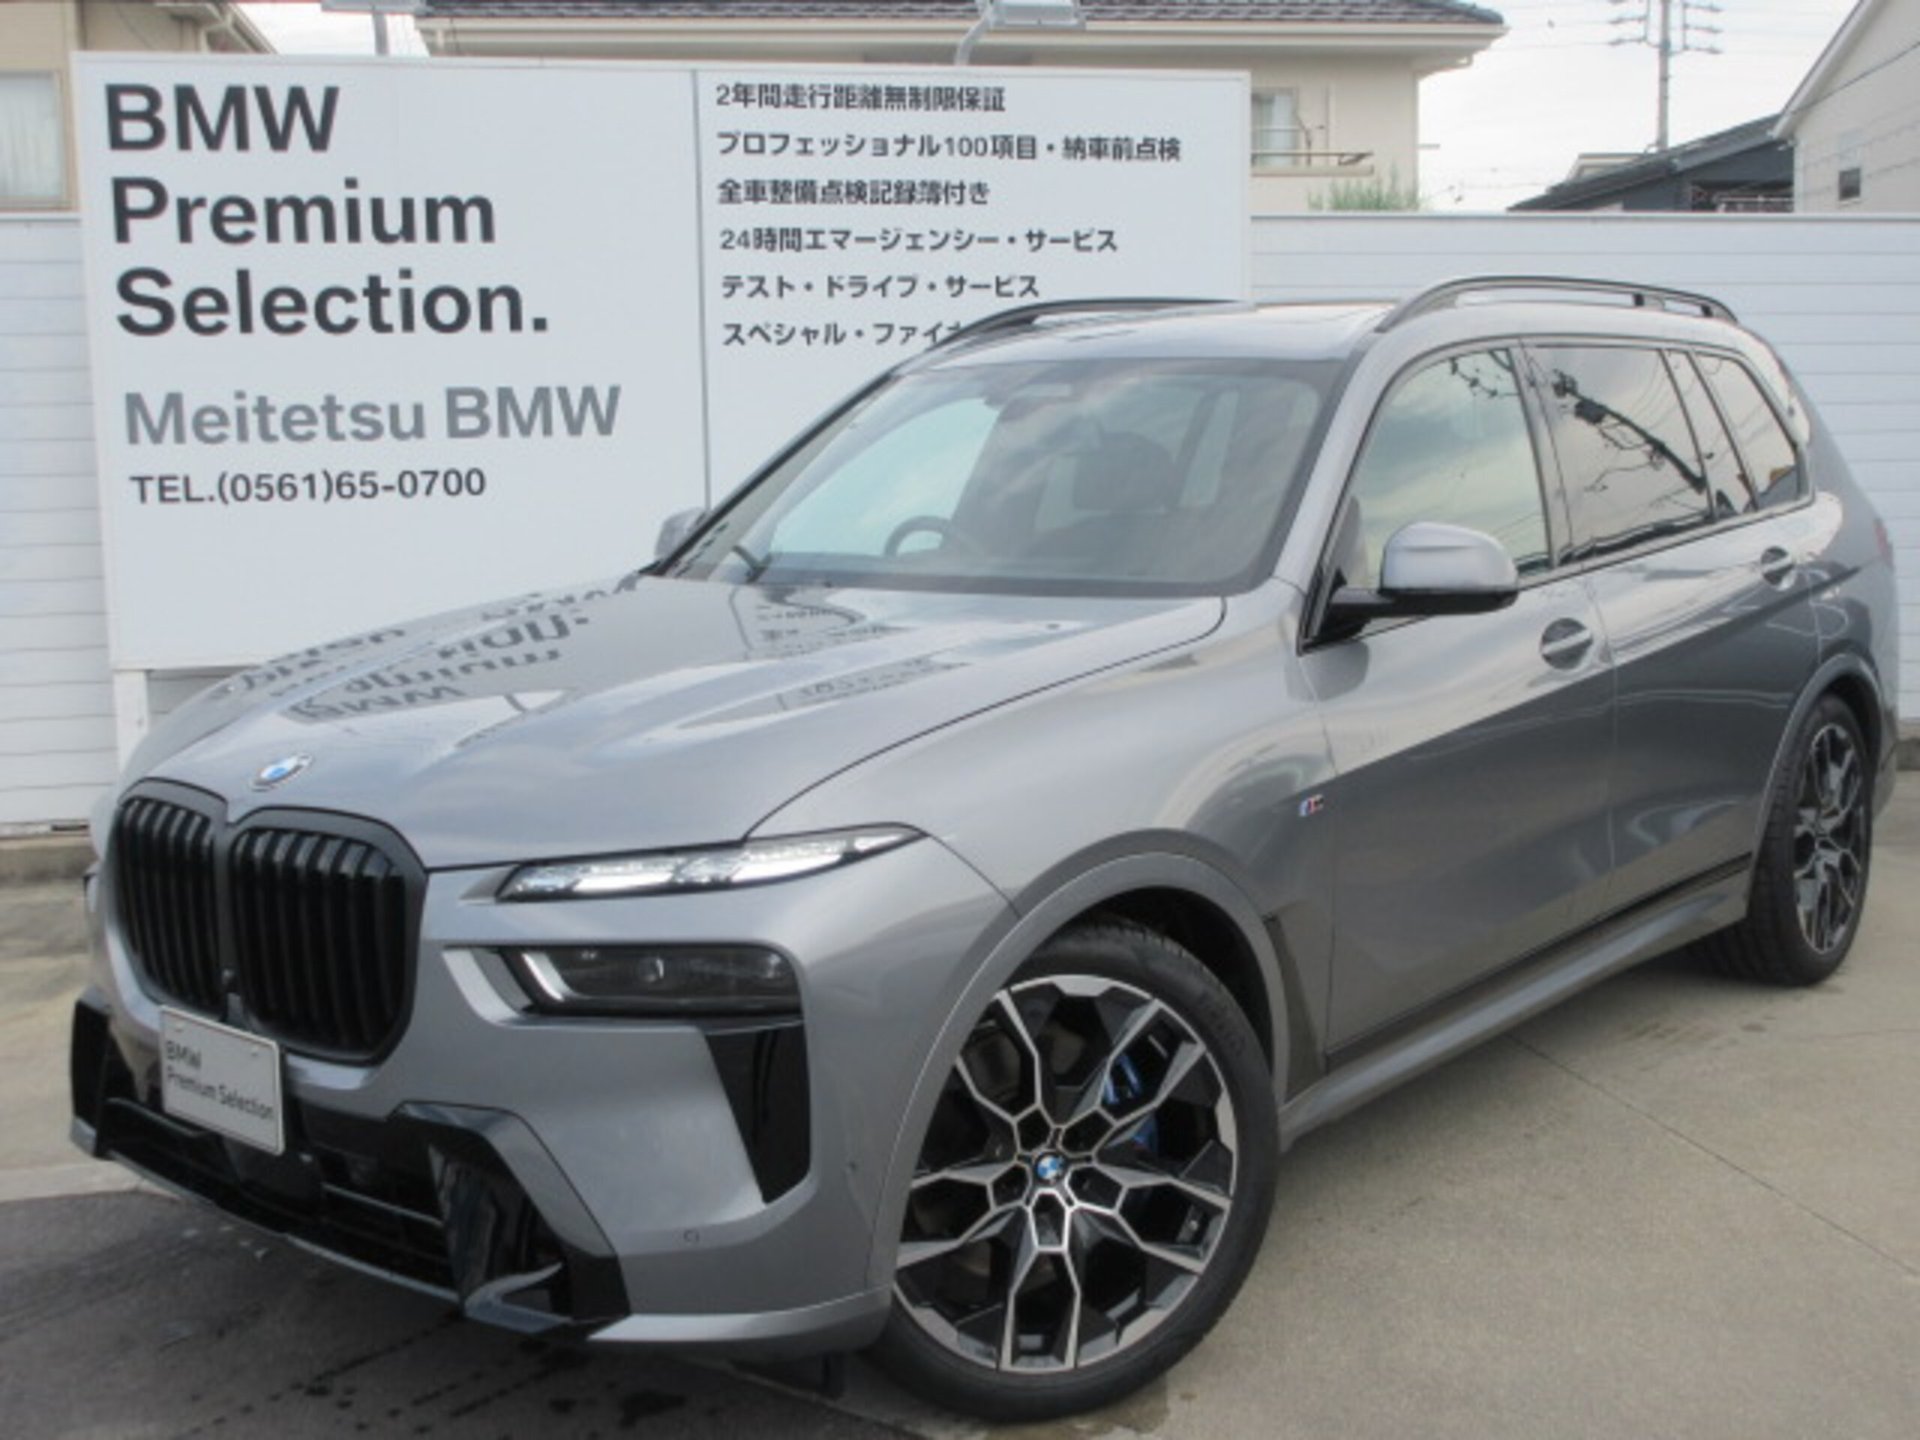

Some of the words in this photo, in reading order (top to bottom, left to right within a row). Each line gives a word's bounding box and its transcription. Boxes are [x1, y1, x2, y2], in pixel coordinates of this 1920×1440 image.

[716, 83, 1006, 112] 2年間走行距離無制限保証
[105, 84, 340, 152] BMW
[717, 131, 1181, 162] プロフェッショナル100項目・納車前点検
[717, 179, 990, 206] 全車整備点検記録簿付き
[111, 177, 496, 244] Premium
[720, 227, 1118, 254] 24時間エマージェンシー・サービス
[115, 267, 549, 336] Selection.
[722, 274, 1040, 299] テスト・ドライブ・サービス
[124, 389, 426, 445] Meitetsu
[445, 385, 622, 439] BMW
[129, 468, 487, 505] TEL.(0561)65-0700
